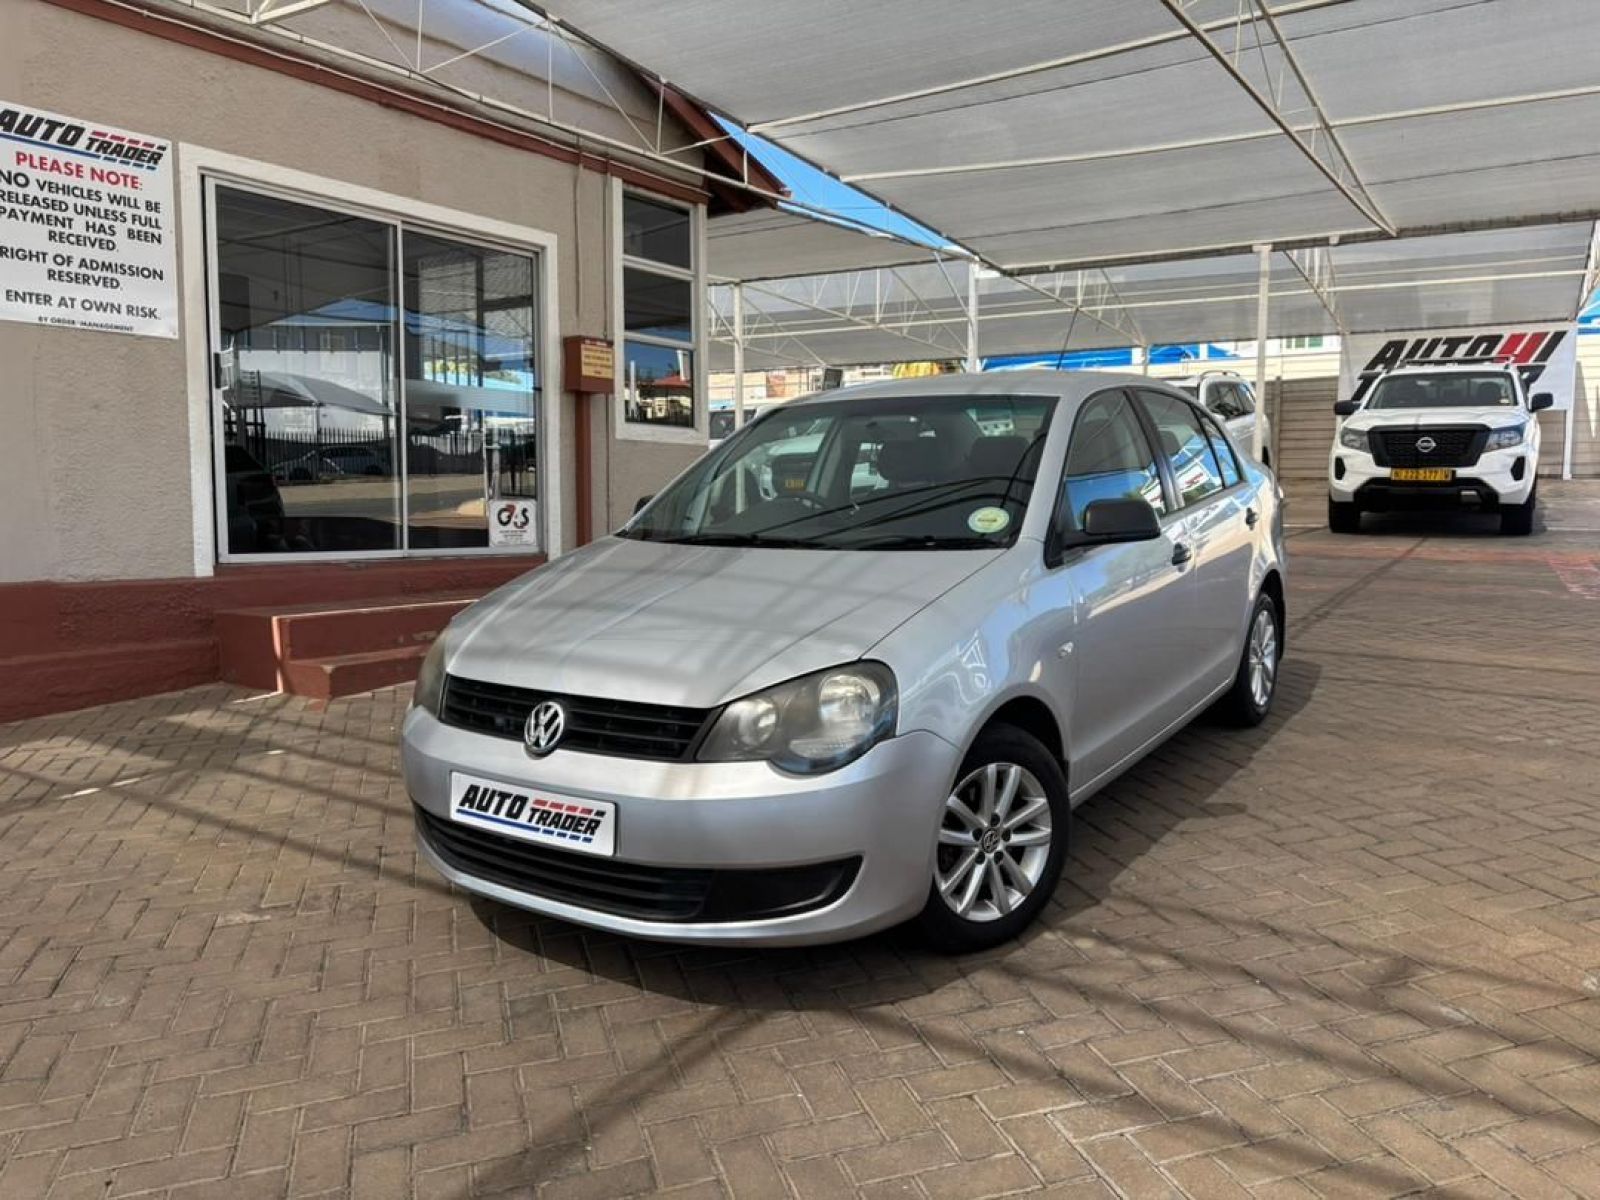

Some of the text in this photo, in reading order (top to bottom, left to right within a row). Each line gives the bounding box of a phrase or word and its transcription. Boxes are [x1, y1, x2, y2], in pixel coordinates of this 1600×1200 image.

[0, 109, 163, 165] AUTO TRADER
[0, 168, 161, 214] NO VEHICLES WILL BE
[16, 151, 143, 191] PLEASE NOTE:
[0, 189, 162, 230] RELEASED UNLESS FULL
[0, 206, 162, 245] PAYMENT HAS BEEN
[48, 228, 119, 253] RECEIVED.
[0, 245, 164, 281] RIGHT OF ADMISSION
[5, 289, 53, 307] ENTER
[58, 296, 77, 309] AT
[81, 299, 122, 315] OWN
[459, 784, 602, 836] AUTO TRADER
